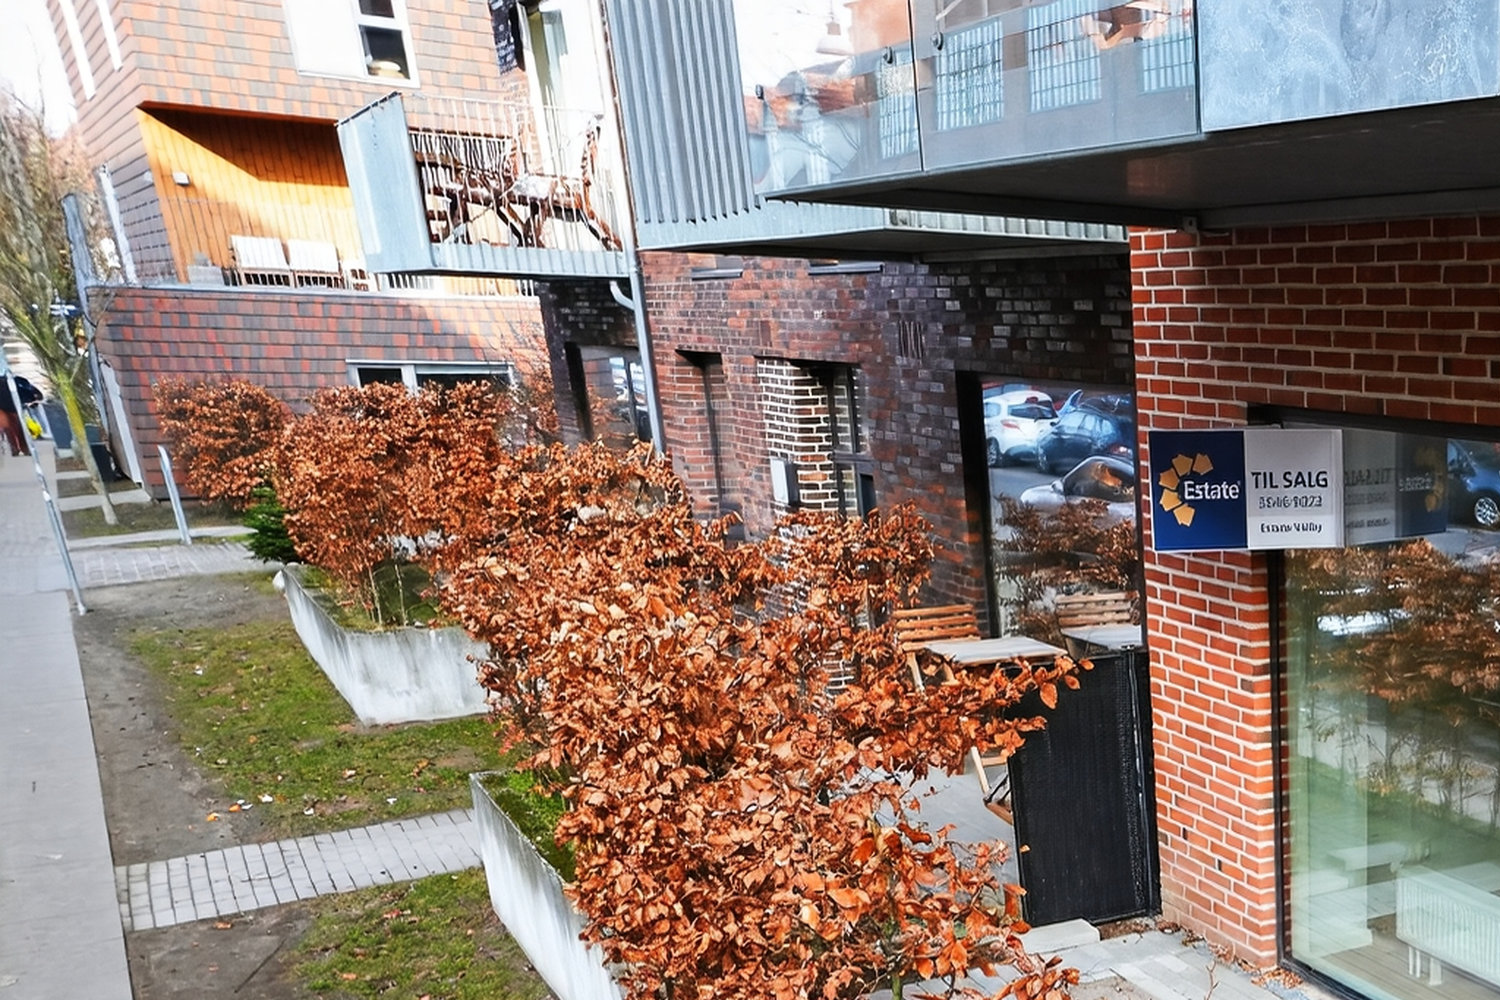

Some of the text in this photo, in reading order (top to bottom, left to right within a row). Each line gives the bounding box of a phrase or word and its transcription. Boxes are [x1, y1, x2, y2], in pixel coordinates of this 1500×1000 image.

[1251, 471, 1328, 489] TIL SALG
[1184, 481, 1240, 499] Estate
